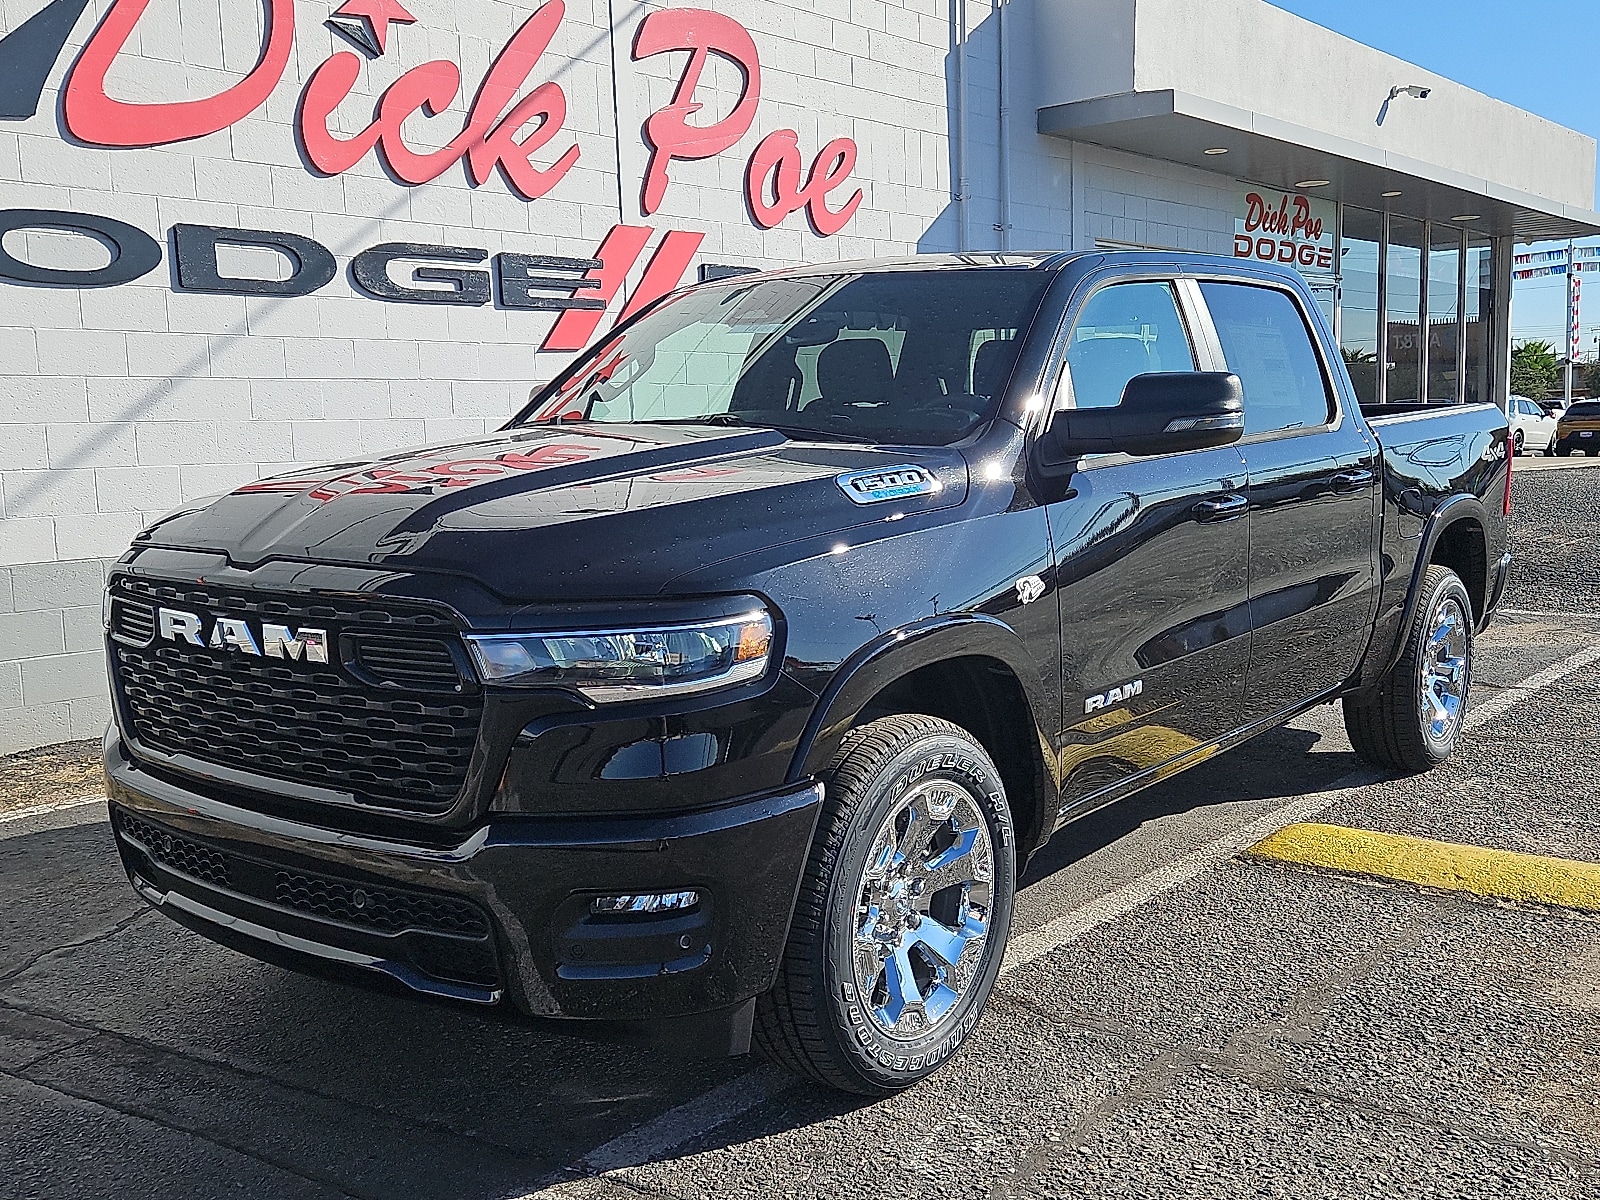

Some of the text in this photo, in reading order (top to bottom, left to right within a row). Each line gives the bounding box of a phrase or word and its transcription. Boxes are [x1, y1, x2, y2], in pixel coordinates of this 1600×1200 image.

[64, 0, 865, 236] Dick Poe
[1245, 192, 1324, 241] Dick Poe
[1234, 234, 1333, 268] DODGE
[855, 470, 922, 492] 1500
[158, 606, 329, 665] RAM
[1084, 679, 1144, 715] RAM
[890, 753, 987, 805] DUELER
[841, 981, 979, 1071] BRIDGESTONE
